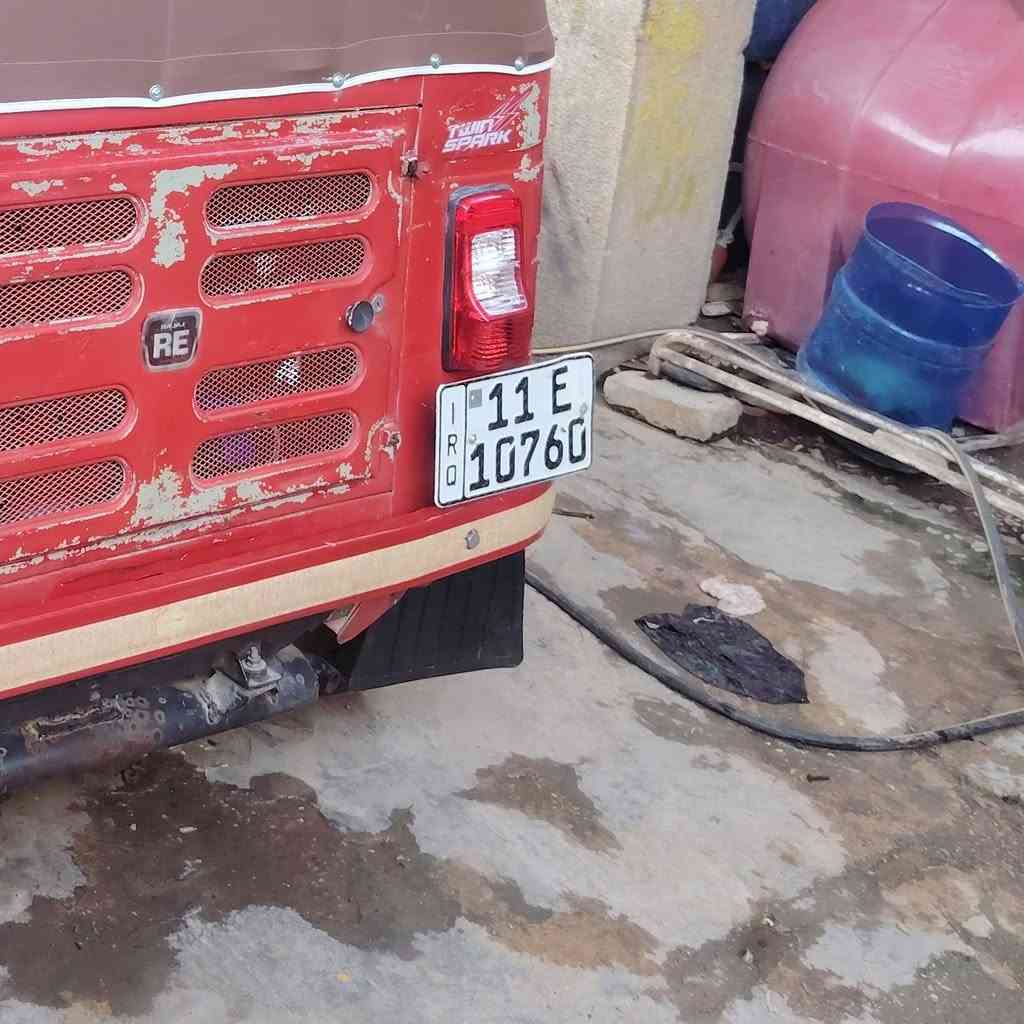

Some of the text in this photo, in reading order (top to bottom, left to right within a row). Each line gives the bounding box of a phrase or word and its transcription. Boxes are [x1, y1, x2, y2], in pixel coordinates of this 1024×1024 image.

[442, 128, 513, 153] SPARK
[152, 329, 190, 359] RE
[488, 365, 572, 431] 11 E
[469, 417, 587, 491] 10760
